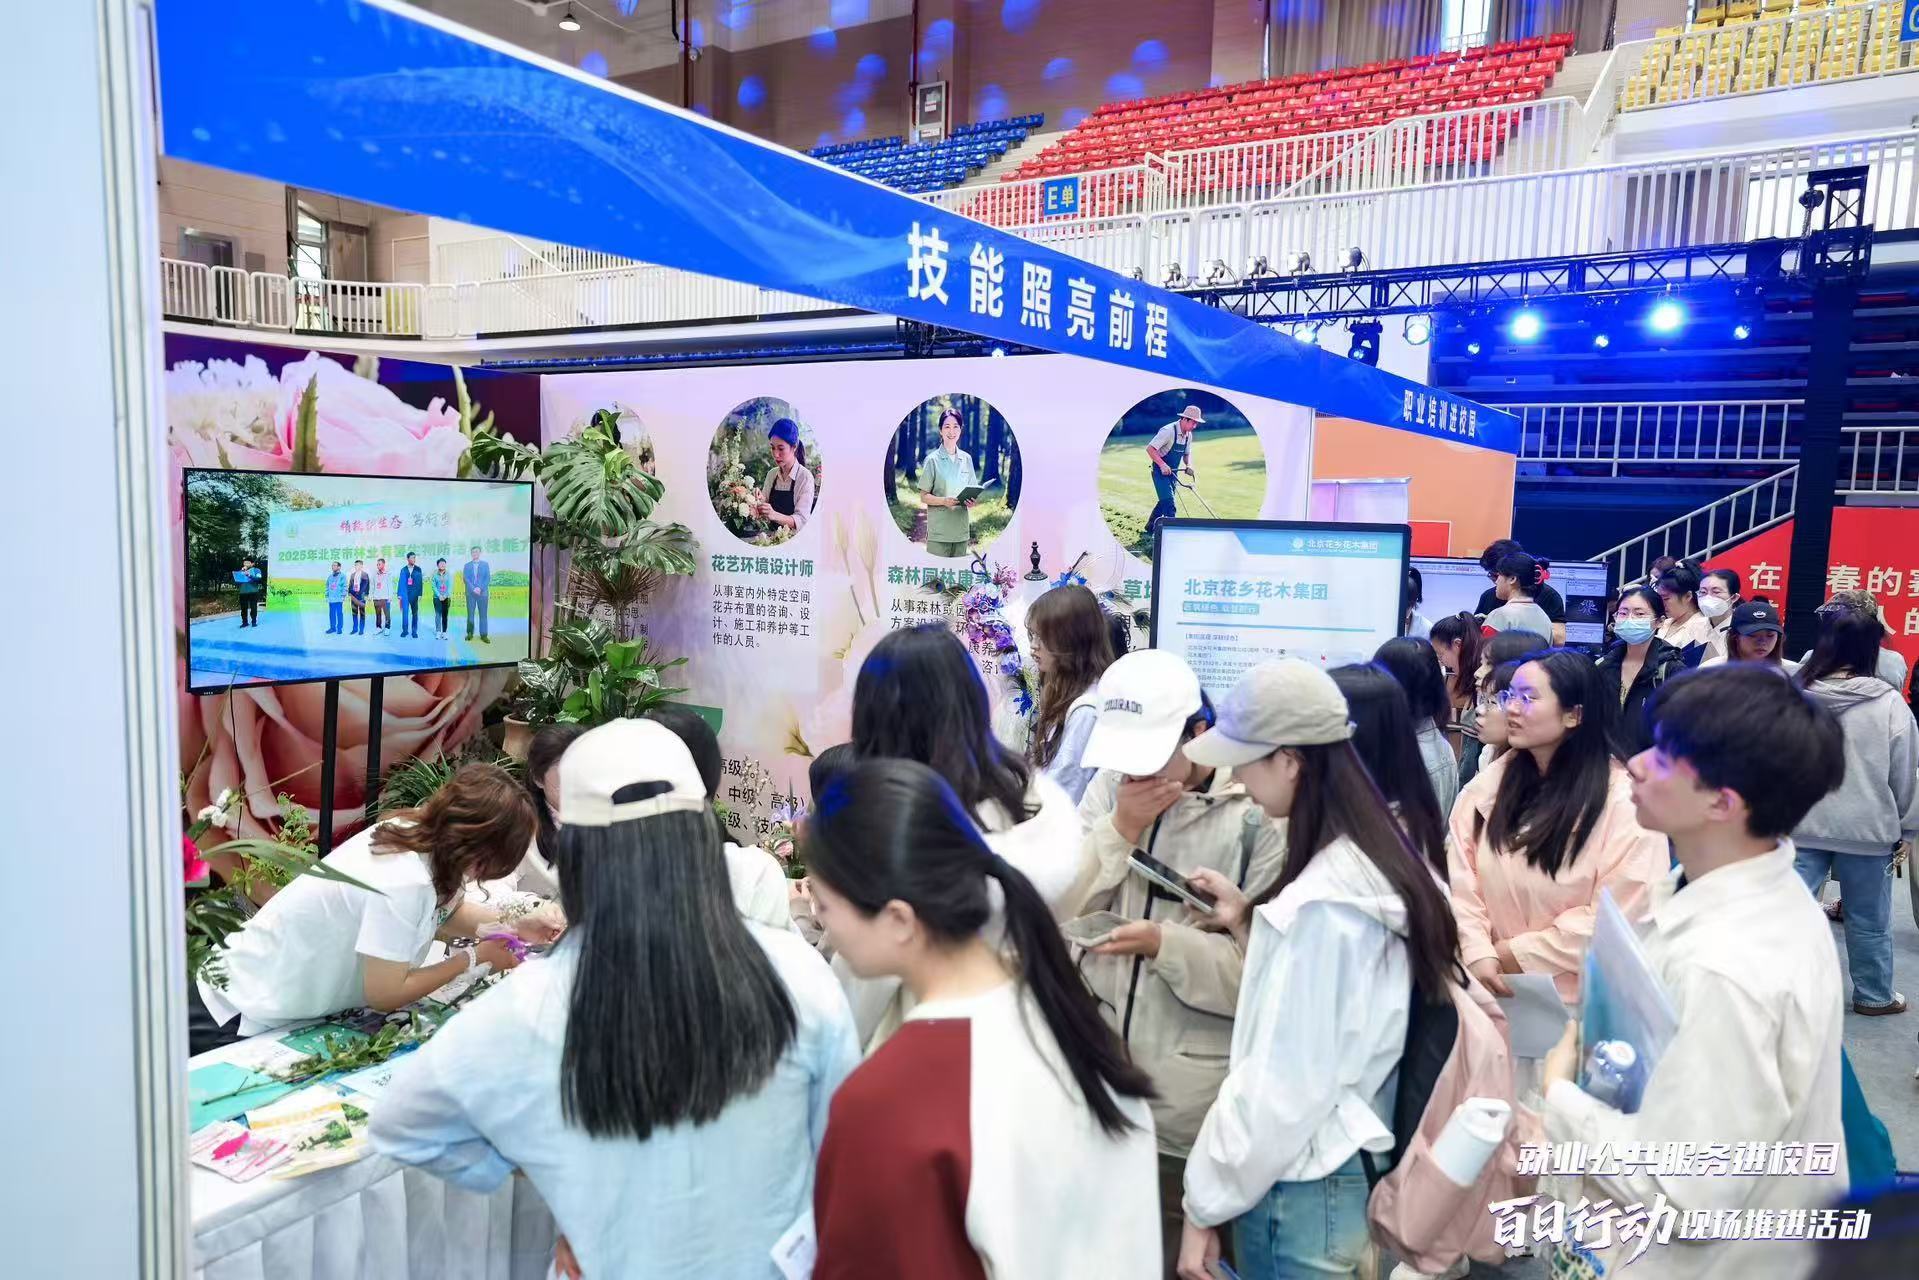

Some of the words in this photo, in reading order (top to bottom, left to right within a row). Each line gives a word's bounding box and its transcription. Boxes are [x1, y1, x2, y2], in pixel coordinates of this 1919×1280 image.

[907, 221, 1168, 359] 技能照亮前程
[1403, 389, 1476, 438] 职业培训进校园
[711, 554, 814, 578] 花艺环境设计师
[713, 584, 810, 604] 从事室内外特定空间
[1184, 578, 1328, 600] 北京花乡花木集团
[713, 600, 810, 620] 花卉布置的咨询、设
[713, 616, 810, 637] 计、施工和养护等工
[713, 632, 760, 648] 作的人员。
